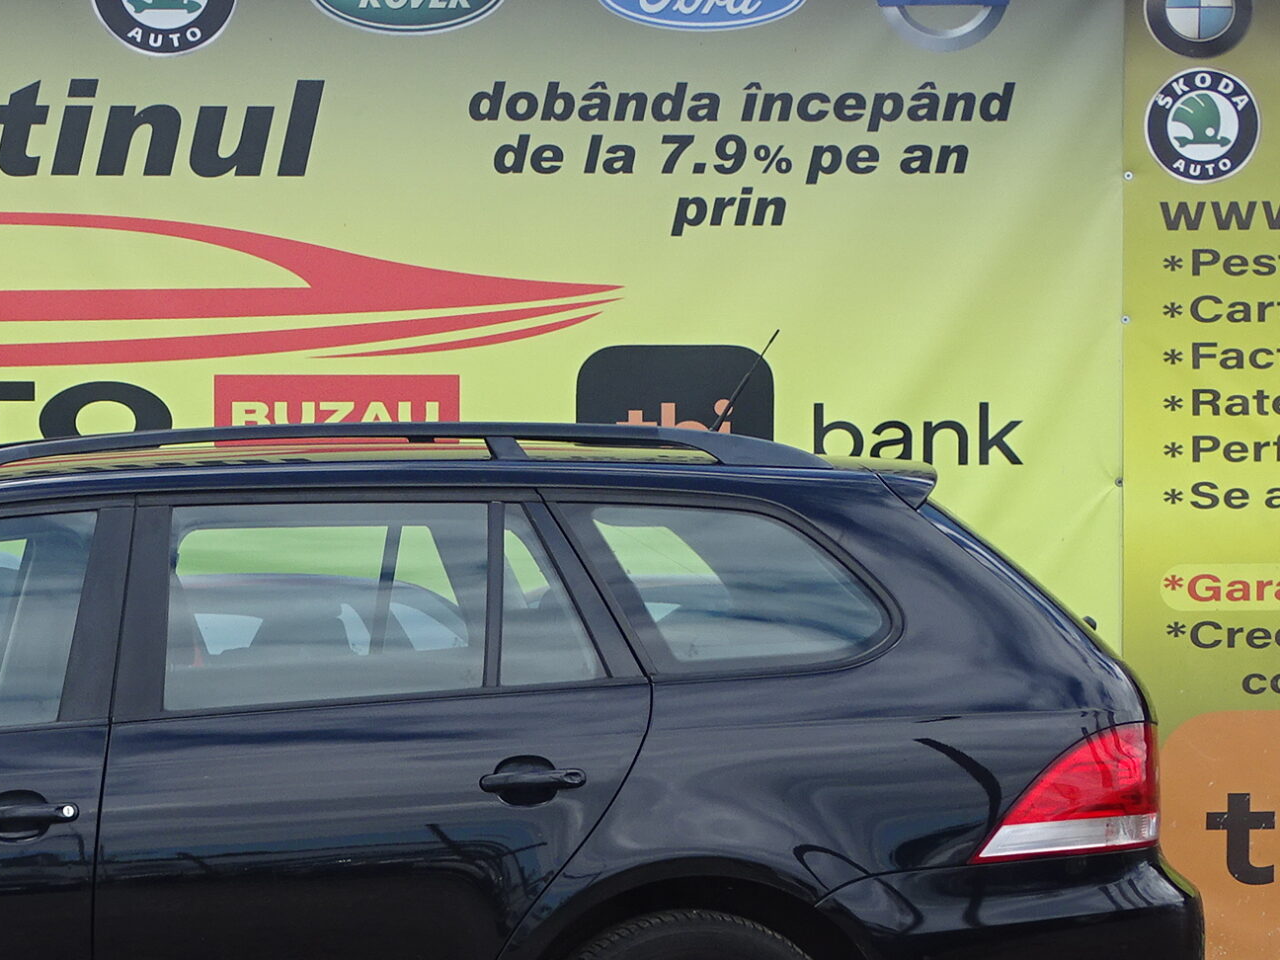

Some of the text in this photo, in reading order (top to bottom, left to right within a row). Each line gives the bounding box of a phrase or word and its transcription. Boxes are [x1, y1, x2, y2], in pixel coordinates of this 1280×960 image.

[127, 27, 202, 48] AUTO
[469, 81, 1016, 132] dobânda începând
[494, 134, 563, 174] de
[584, 135, 635, 174] la
[806, 145, 879, 184] pe
[900, 145, 968, 174] an
[1172, 158, 1231, 176] AUTO
[671, 187, 786, 236] prin
[1164, 249, 1280, 276] Pes
[1163, 295, 1280, 323] Car
[1164, 342, 1280, 369] Fac
[814, 402, 1023, 465] bank
[1163, 574, 1280, 602] Gar
[1167, 621, 1280, 649] Cre
